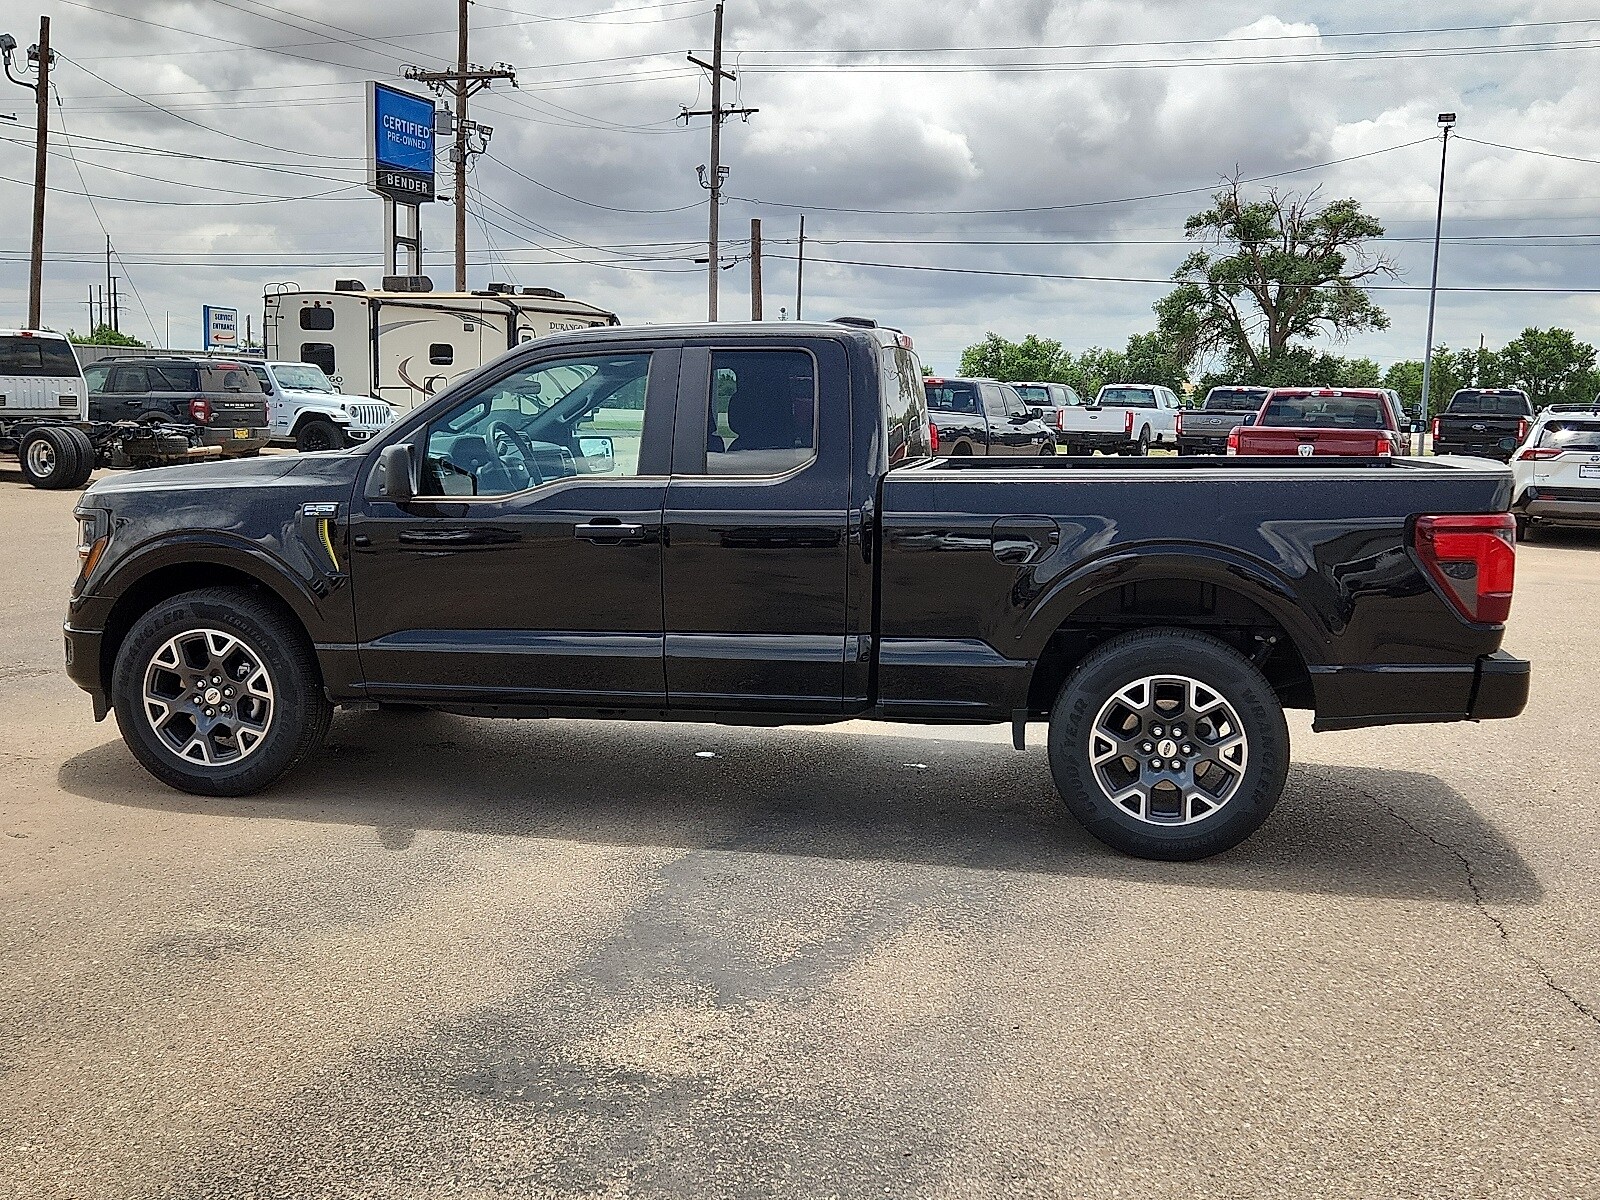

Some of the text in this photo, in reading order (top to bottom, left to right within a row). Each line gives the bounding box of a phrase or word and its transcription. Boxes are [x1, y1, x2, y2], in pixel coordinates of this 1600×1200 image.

[383, 114, 430, 139] CERTIFIED
[387, 130, 427, 150] PRE-OWNED
[387, 173, 428, 193] BENDER
[212, 322, 235, 332] ENTRANCE
[214, 313, 234, 322] SERVICE
[549, 322, 584, 331] DURANGO
[222, 613, 271, 652] TERRITORY
